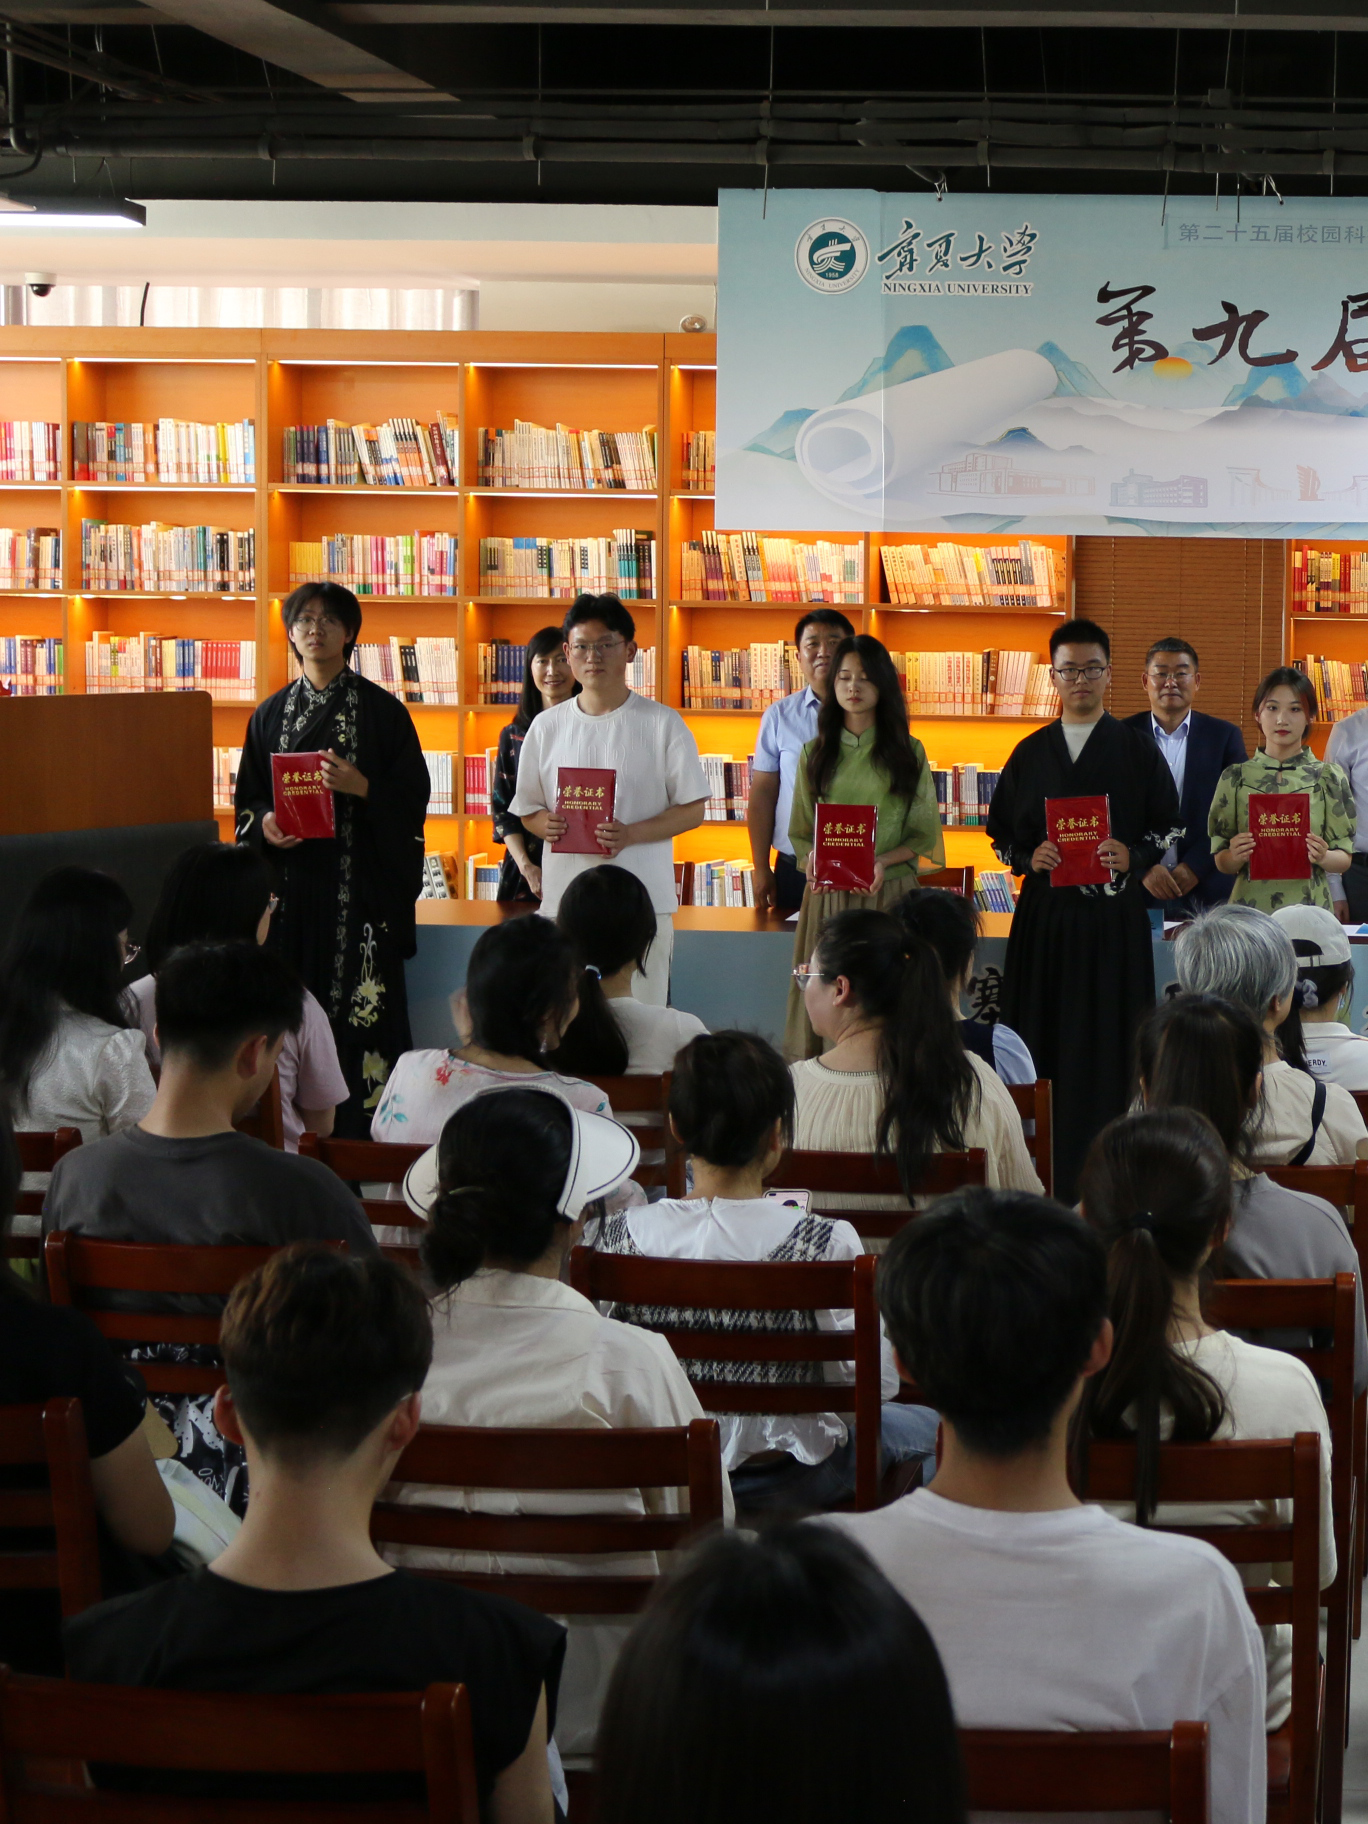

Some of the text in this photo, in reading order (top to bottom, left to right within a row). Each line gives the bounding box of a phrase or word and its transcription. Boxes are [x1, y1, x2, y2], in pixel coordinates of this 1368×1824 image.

[882, 282, 1032, 295] NINGXIA UNIVERSITY
[562, 786, 605, 799] 荣誉证书
[1056, 816, 1099, 831] 荣誉证书
[1258, 812, 1301, 825] 荣誉证书
[823, 822, 866, 835] 荣誉证书
